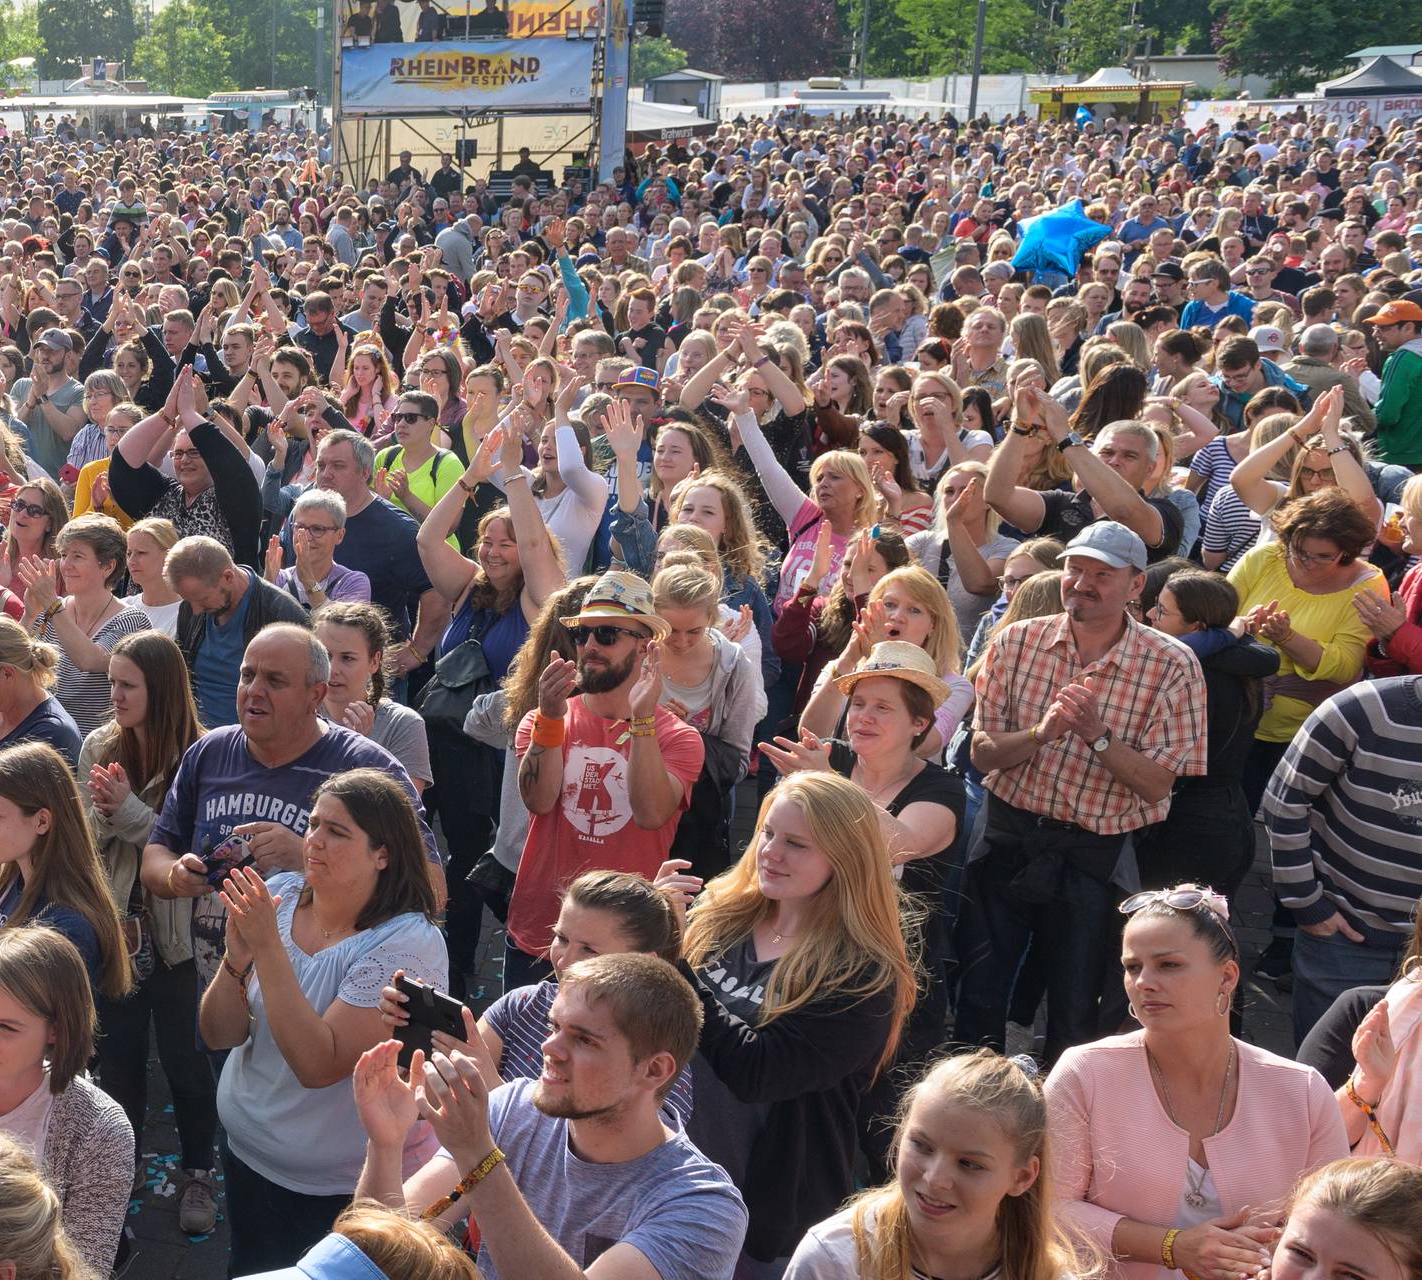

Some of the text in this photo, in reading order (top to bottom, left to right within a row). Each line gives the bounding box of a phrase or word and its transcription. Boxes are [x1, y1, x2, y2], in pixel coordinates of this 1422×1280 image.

[389, 56, 541, 77] RHEINBRAND
[461, 74, 540, 86] FESTIVAL
[205, 792, 310, 834] HAMBURGE
